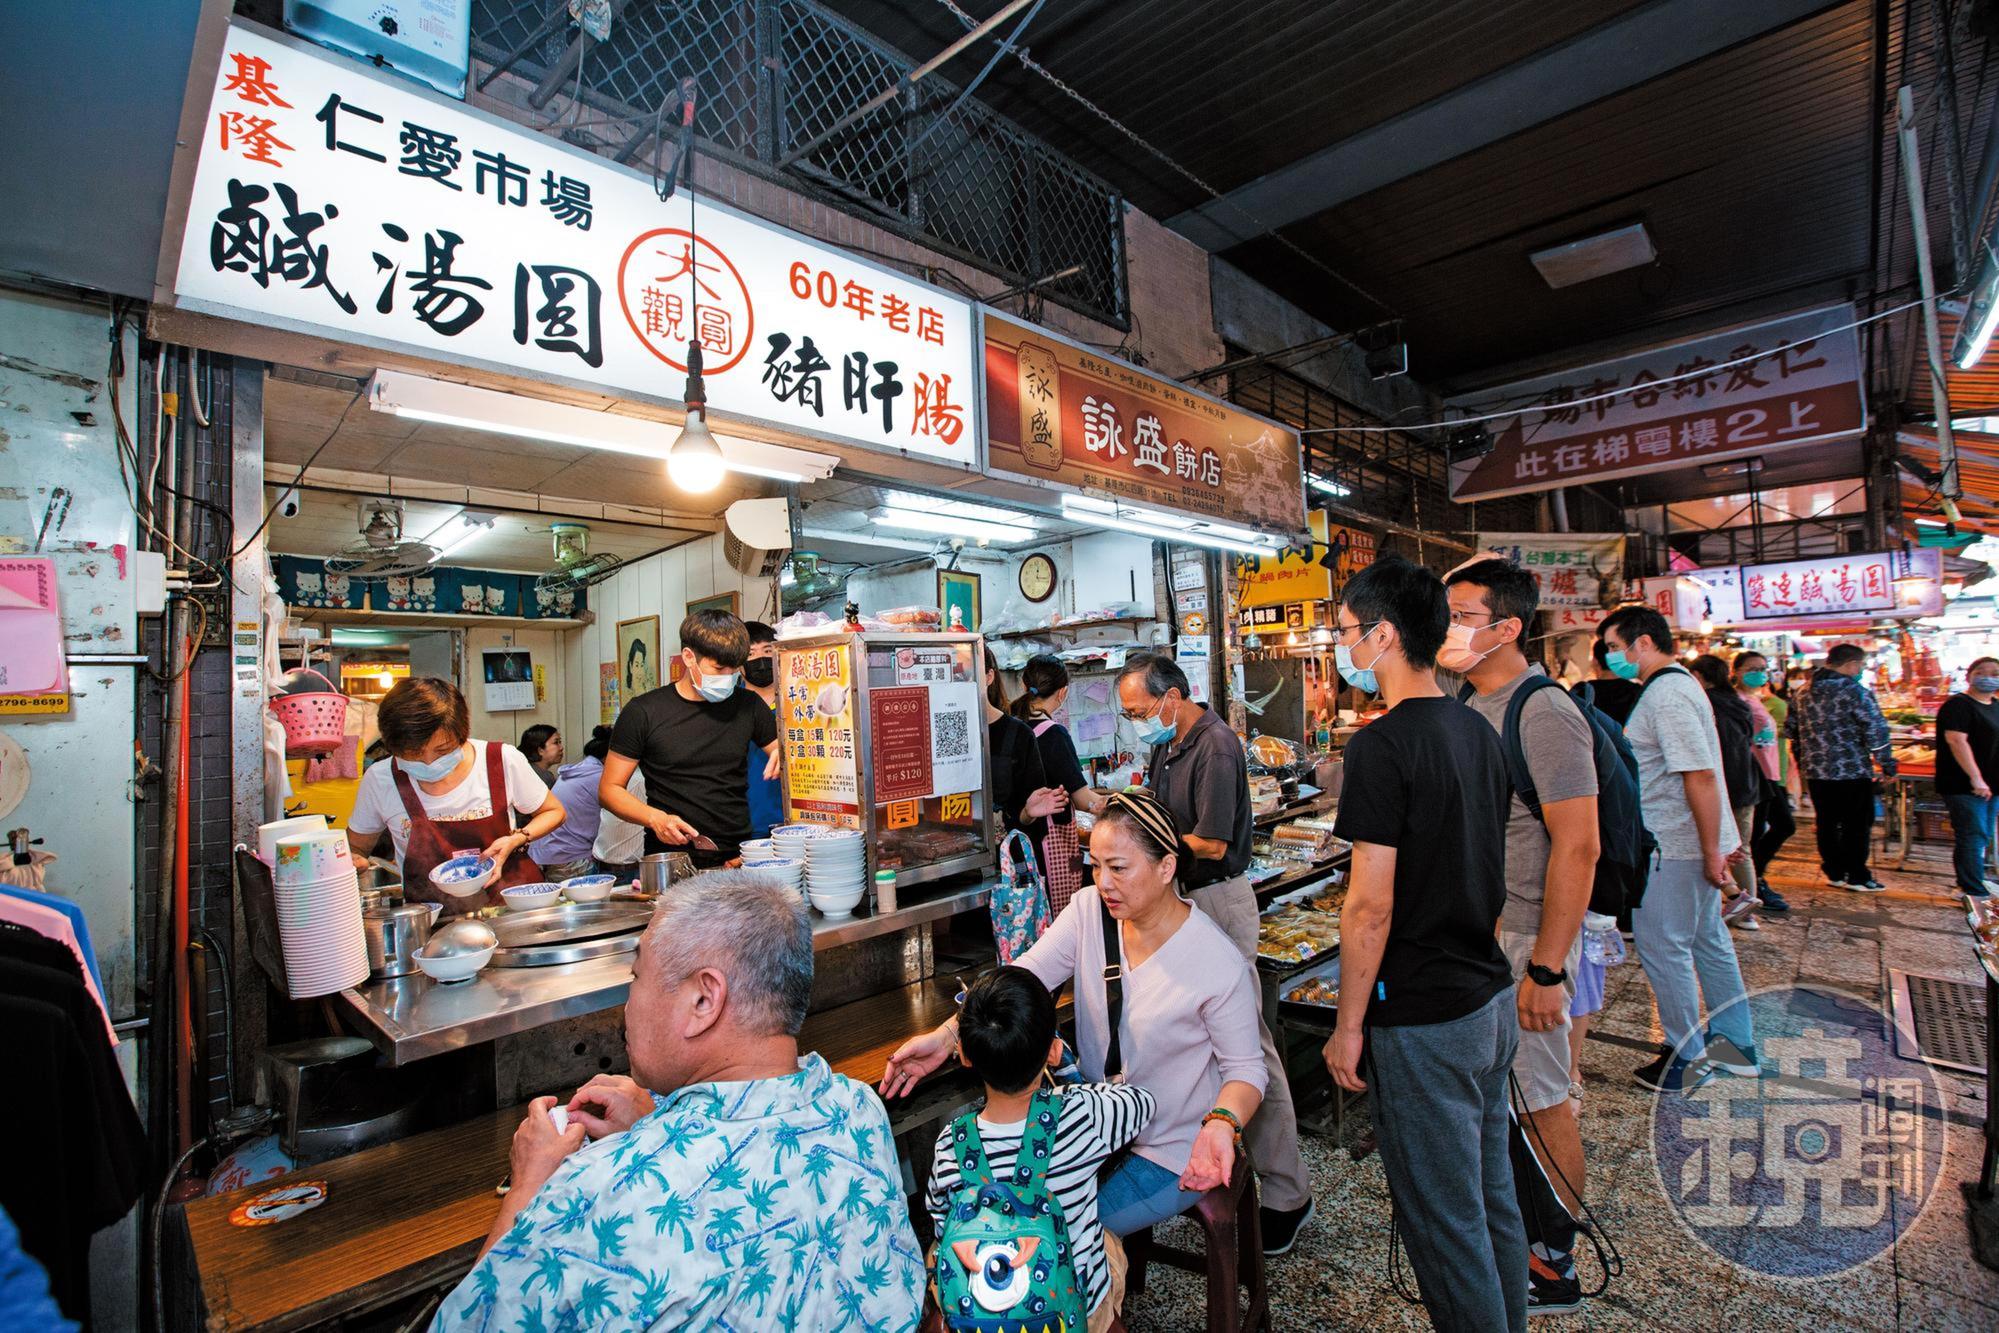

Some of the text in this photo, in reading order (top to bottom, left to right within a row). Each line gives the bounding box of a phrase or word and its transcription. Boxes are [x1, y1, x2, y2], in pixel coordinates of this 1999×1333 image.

[220, 53, 295, 168] 基隆
[316, 93, 594, 231] 仁愛市場
[210, 178, 604, 369] 鹹湯圓
[789, 261, 946, 347] 60年老店
[1081, 396, 1222, 487] 詠盛餅店
[1748, 564, 1887, 609] 雙連鹹湯圓
[900, 768, 922, 781] $120
